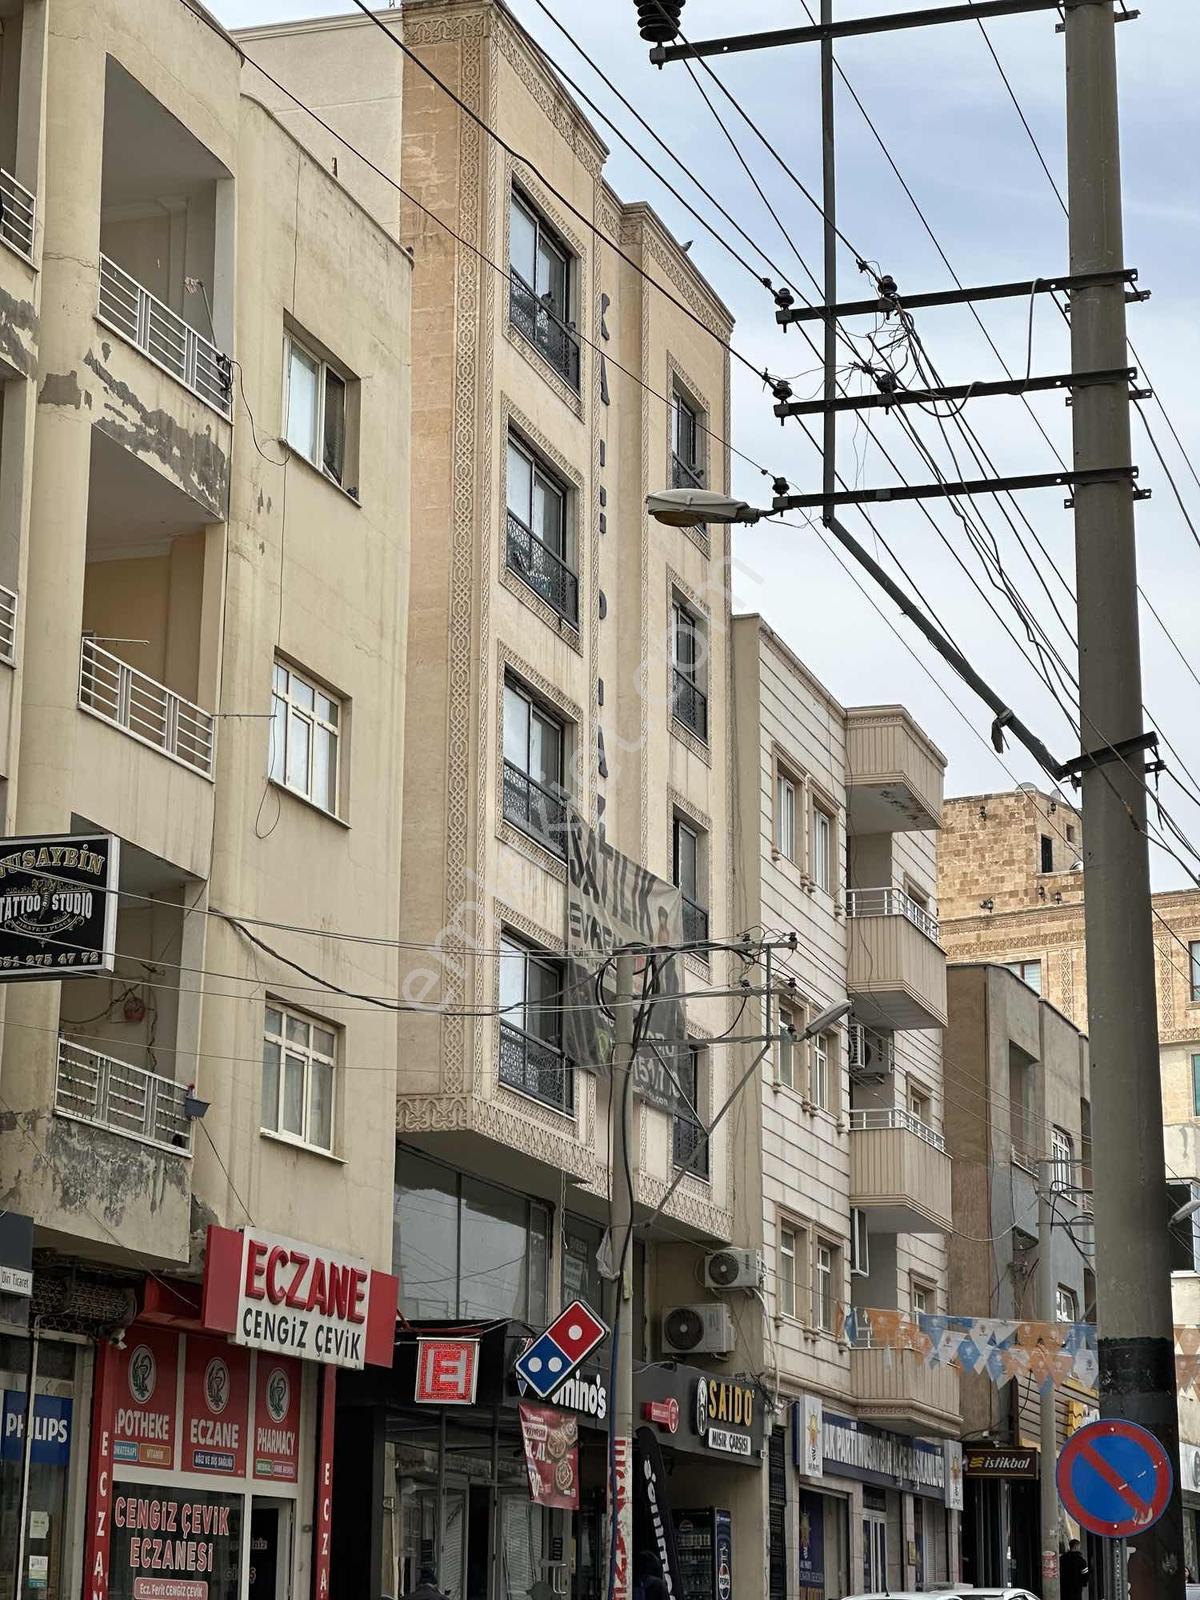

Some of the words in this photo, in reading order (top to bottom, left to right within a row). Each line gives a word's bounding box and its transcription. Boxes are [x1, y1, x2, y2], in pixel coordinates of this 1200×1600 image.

[0, 843, 105, 878] USAYBİN
[568, 812, 657, 943] SATILIK
[51, 892, 93, 919] STUDIO
[57, 952, 76, 965] 47
[81, 951, 99, 963] 72
[244, 1239, 367, 1325] ECZANE
[242, 1307, 309, 1349] CENGİZ
[315, 1324, 361, 1361] ÇEVİK
[552, 1369, 607, 1419] mino's
[115, 1408, 170, 1440] POTHEKE
[190, 1419, 240, 1449] ECZANE
[256, 1427, 296, 1456] PHARMACY
[984, 1457, 1031, 1468] istikbal
[114, 1496, 178, 1532] CENGİZ
[181, 1503, 230, 1539] ÇEVİK
[320, 1462, 331, 1600] ECZA
[129, 1536, 213, 1572] ECZANESİ
